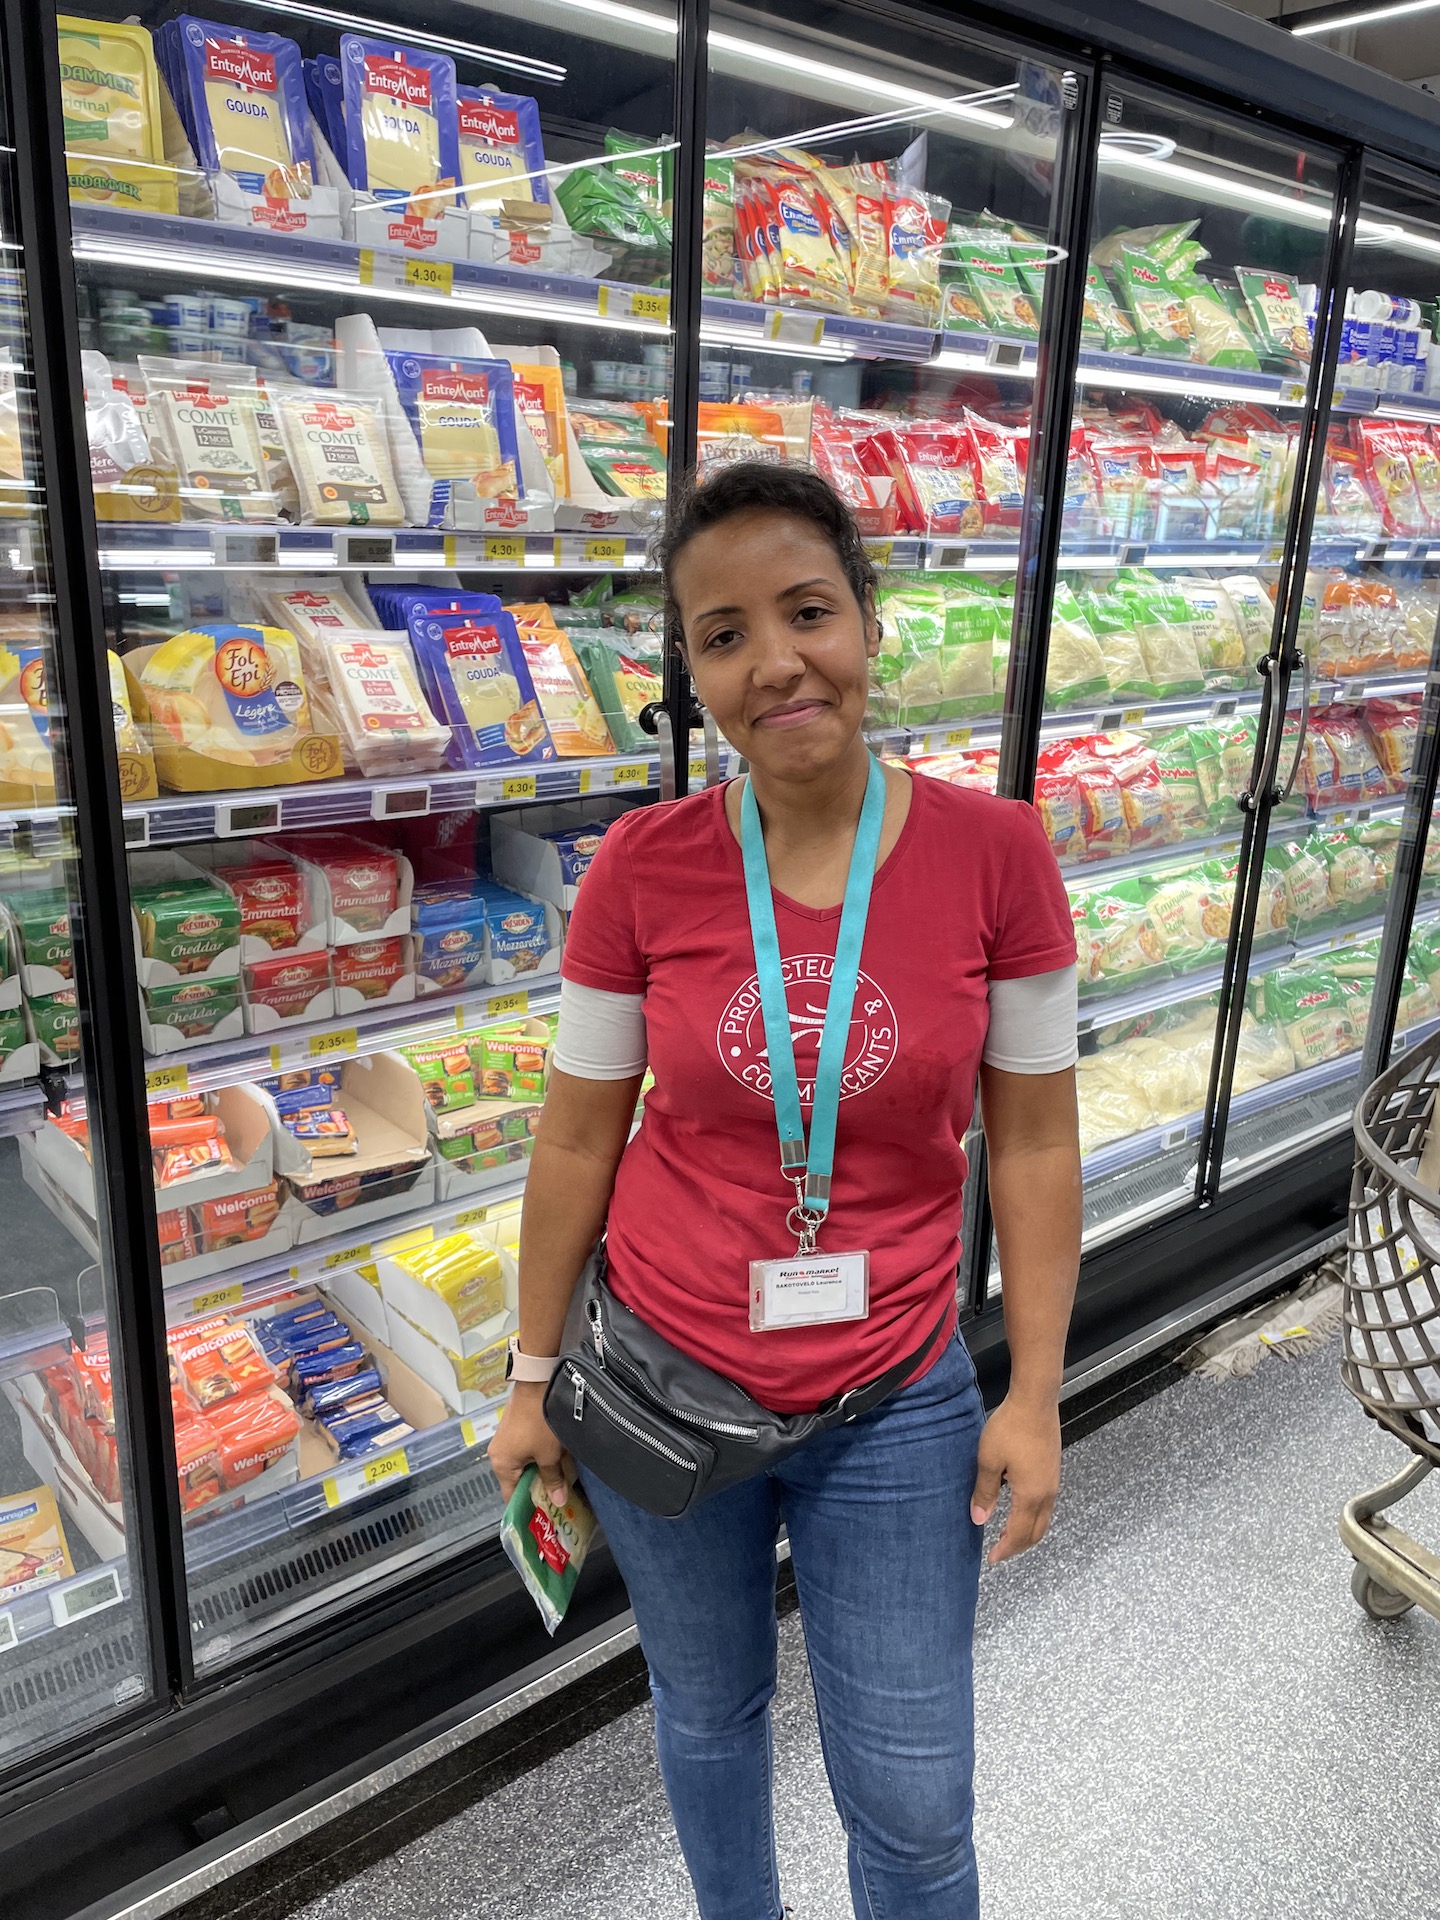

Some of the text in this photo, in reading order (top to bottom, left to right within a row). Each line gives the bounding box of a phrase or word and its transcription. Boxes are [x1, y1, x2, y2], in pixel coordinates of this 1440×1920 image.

[210, 55, 273, 85] EntreMont
[369, 71, 427, 101] EntreMont
[226, 98, 269, 118] GOUDA
[461, 114, 516, 142] EntreMont
[474, 151, 512, 169] GOUDA
[389, 224, 438, 243] EntreMont
[411, 266, 442, 283] 4.30€
[426, 382, 486, 402] EntreMont
[177, 408, 240, 426] COMTÉ
[303, 411, 354, 428] EntreMont
[198, 434, 209, 445] 12
[307, 430, 366, 446] COMTÉ
[326, 452, 337, 462] 12
[485, 501, 528, 522] EntreMont
[490, 544, 517, 556] 4.30€
[592, 546, 615, 556] 4.30€
[293, 605, 344, 616] COMTÉ
[449, 635, 499, 654] EntreMont
[225, 647, 255, 671] Fol
[342, 651, 388, 666] EntreMont
[230, 663, 261, 690] Epi
[347, 666, 400, 680] COMTÉ
[466, 667, 501, 681] GOUDA
[235, 703, 277, 720] Légère
[306, 741, 325, 758] Fol
[309, 752, 328, 770] Epi
[618, 769, 641, 779] 4.30€
[507, 781, 533, 794] 4.30€
[334, 890, 392, 907] Emmental
[240, 902, 304, 922] Emmental
[177, 917, 223, 932] PRÉSIDENT
[501, 916, 535, 930] PRÉSIDENT
[440, 932, 473, 948] PRÉSIDENT
[496, 935, 549, 954] Mozzarella
[171, 942, 224, 958] Cheddar
[428, 952, 482, 972] Mozzarella
[271, 969, 313, 985] PRÉSIDENT
[340, 963, 397, 982] Emmental
[172, 988, 219, 1003] PRÉSIDENT
[495, 998, 519, 1012] 2.35€
[864, 999, 884, 1017] &
[166, 1006, 220, 1025] Cheddar
[318, 1036, 346, 1051] 2.35€
[486, 1040, 543, 1056] Welcome
[414, 1045, 467, 1064] Welcome
[303, 1175, 360, 1199] Welcome
[214, 1191, 276, 1217] Welcome
[463, 1208, 488, 1223] 2.20€
[334, 1248, 361, 1264] 2.20€
[201, 1291, 232, 1308] 2.20€
[180, 1328, 247, 1363] Welcome
[370, 1459, 399, 1478] 2.20€
